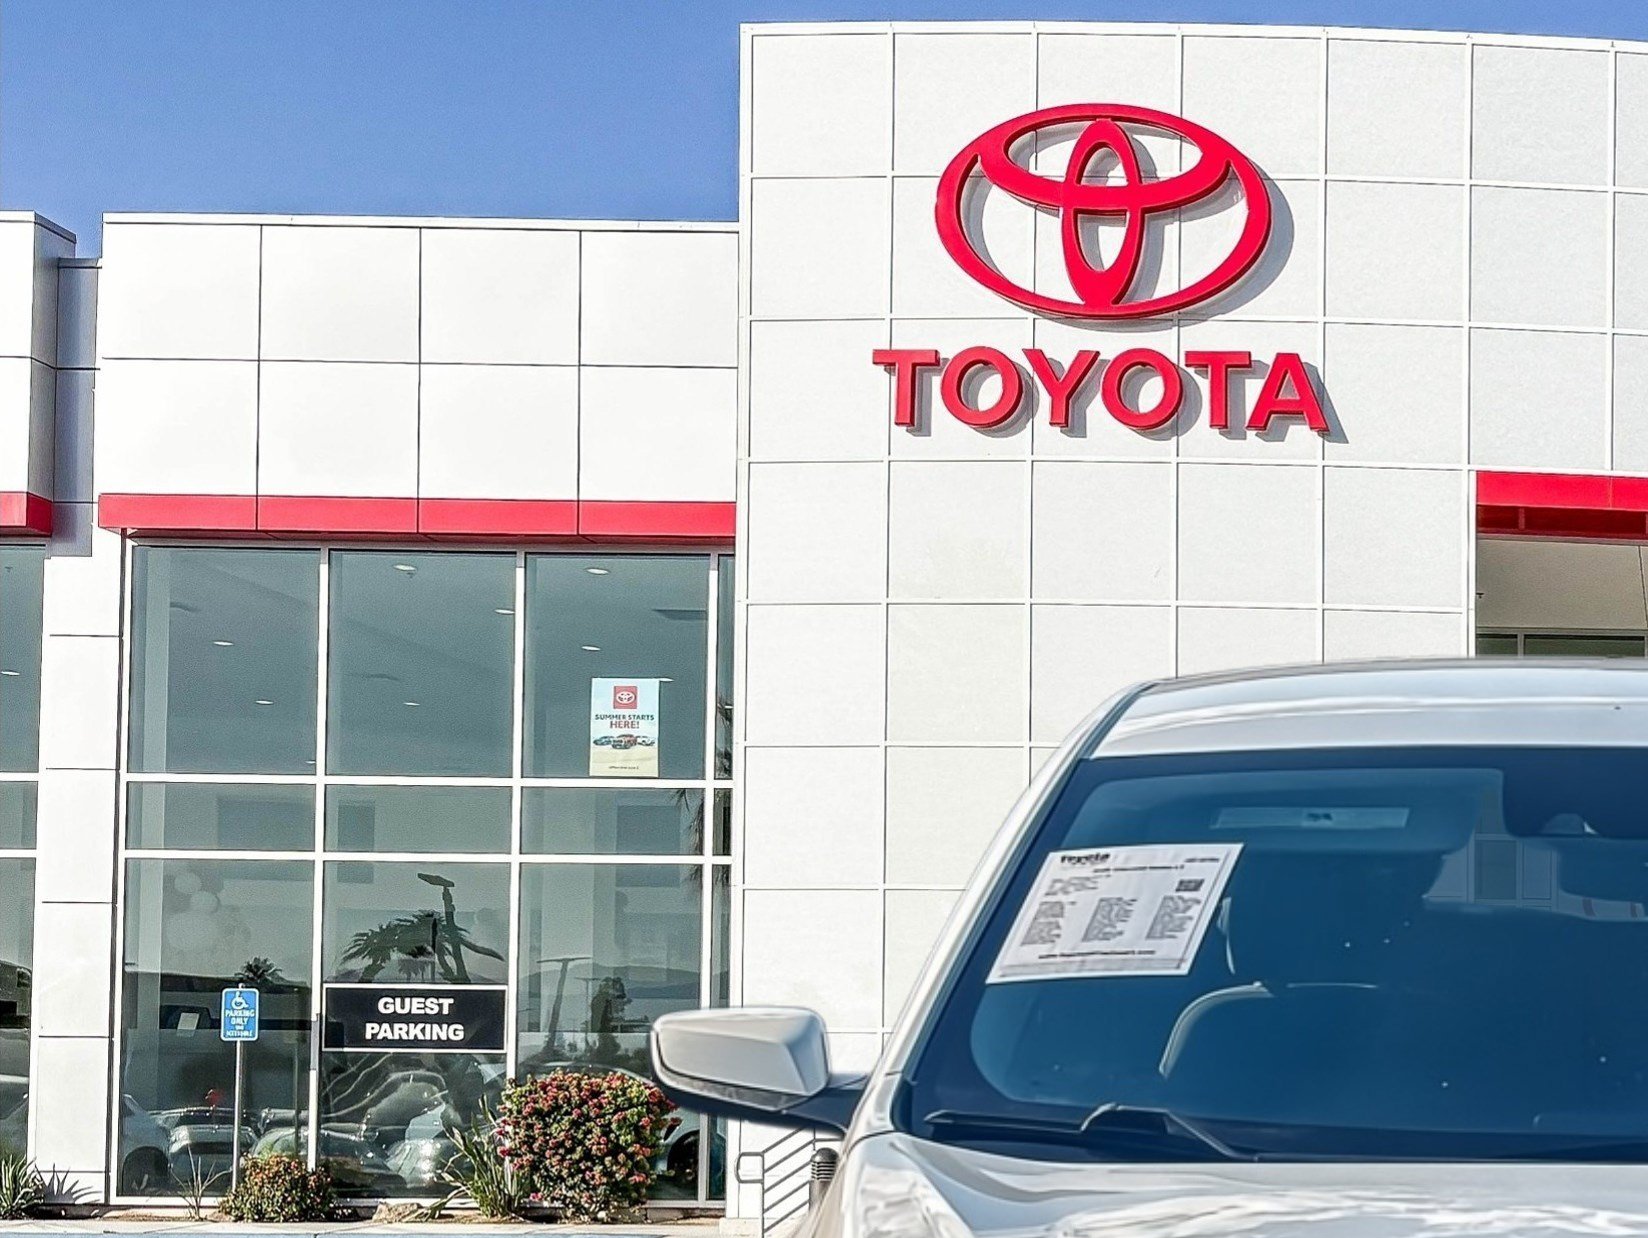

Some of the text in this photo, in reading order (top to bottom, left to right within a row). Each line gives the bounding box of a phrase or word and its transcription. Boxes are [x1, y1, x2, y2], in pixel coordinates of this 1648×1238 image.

[872, 345, 1328, 432] TOYOTA
[609, 720, 640, 729] HERE!
[377, 997, 454, 1015] GUEST
[365, 1023, 464, 1041] PARKING
